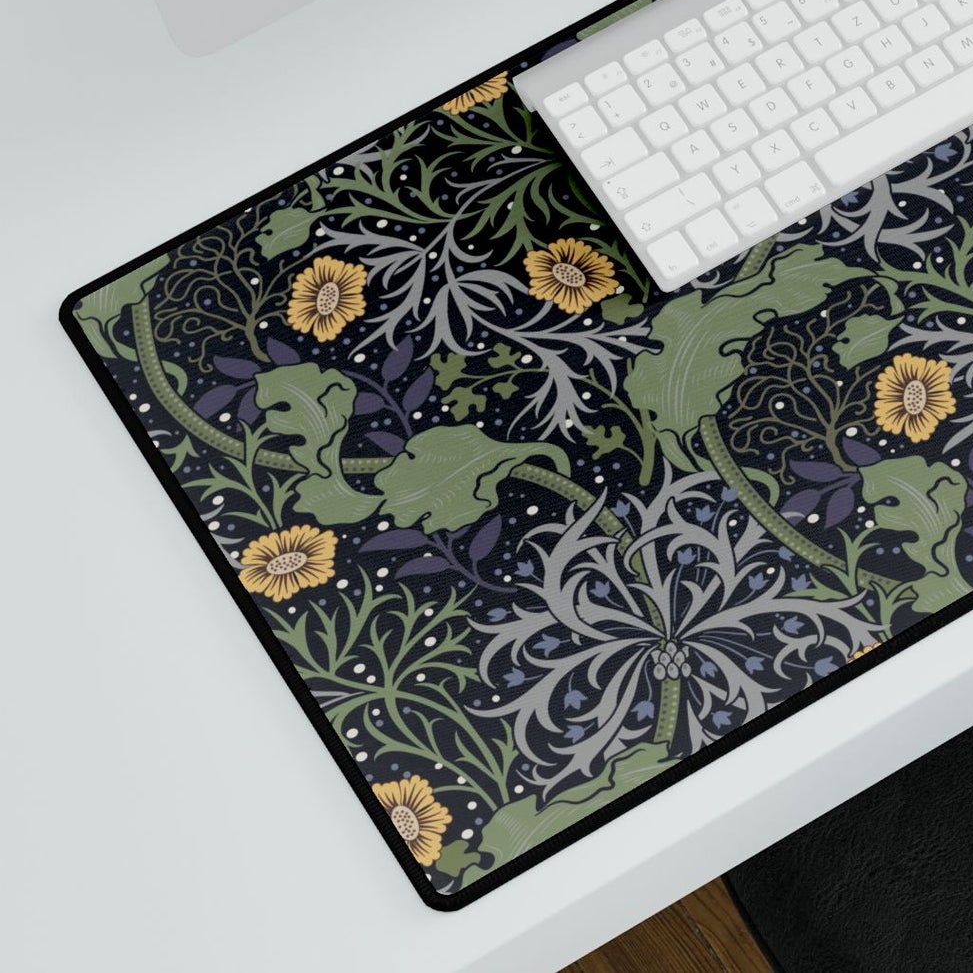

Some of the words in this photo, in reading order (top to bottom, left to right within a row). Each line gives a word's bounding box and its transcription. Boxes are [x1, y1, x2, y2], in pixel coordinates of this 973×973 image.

[759, 15, 769, 26] 5
[851, 15, 863, 28] Z
[921, 17, 929, 28] J
[722, 36, 731, 46] 4
[812, 36, 824, 47] T
[879, 37, 893, 49] H
[682, 57, 692, 68] 3
[775, 58, 787, 69] R
[842, 58, 854, 69] G
[922, 57, 936, 70] N
[643, 78, 654, 89] 2
[736, 78, 748, 90] E
[804, 79, 813, 91] F
[884, 79, 897, 91] B
[695, 98, 710, 112] W
[765, 100, 777, 114] D
[845, 99, 857, 111] V
[658, 120, 673, 132] Q
[727, 122, 738, 133] S
[808, 121, 820, 132] C
[689, 143, 701, 156] A
[768, 141, 782, 155] X
[729, 163, 740, 175] Y
